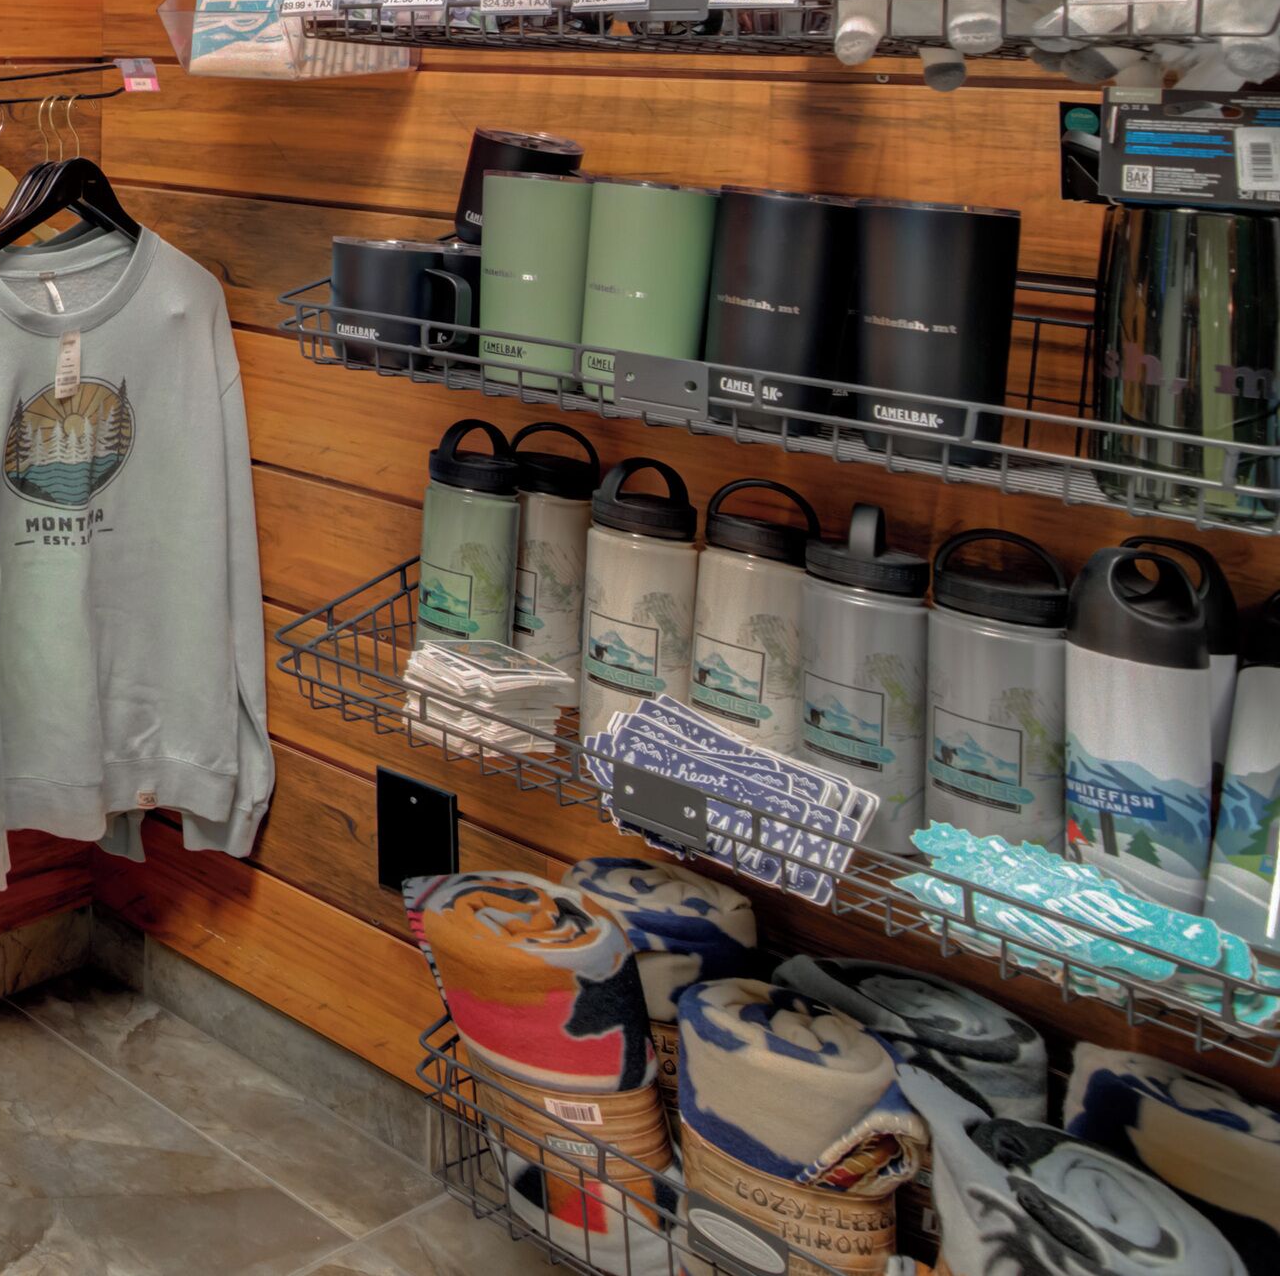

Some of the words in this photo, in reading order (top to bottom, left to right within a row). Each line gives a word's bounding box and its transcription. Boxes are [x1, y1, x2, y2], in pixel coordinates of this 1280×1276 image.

[283, 0, 305, 10] $9.99
[314, 0, 332, 9] TAX
[717, 293, 775, 312] whitefish,
[778, 304, 801, 315] mt
[337, 323, 376, 341] CAMELBAK
[863, 314, 930, 333] whitefish,
[933, 323, 958, 335] mt
[484, 340, 524, 359] CAMELBAK
[588, 355, 616, 373] CAMEL
[720, 377, 778, 402] CAMELAK
[873, 404, 938, 429] CAMELBAK
[43, 535, 76, 546] EST.
[677, 762, 728, 789] heart
[1067, 781, 1155, 809] WHITEFISH
[1078, 796, 1132, 815] MONTANA
[735, 1178, 807, 1221] COZY
[778, 1219, 874, 1257] THROW
